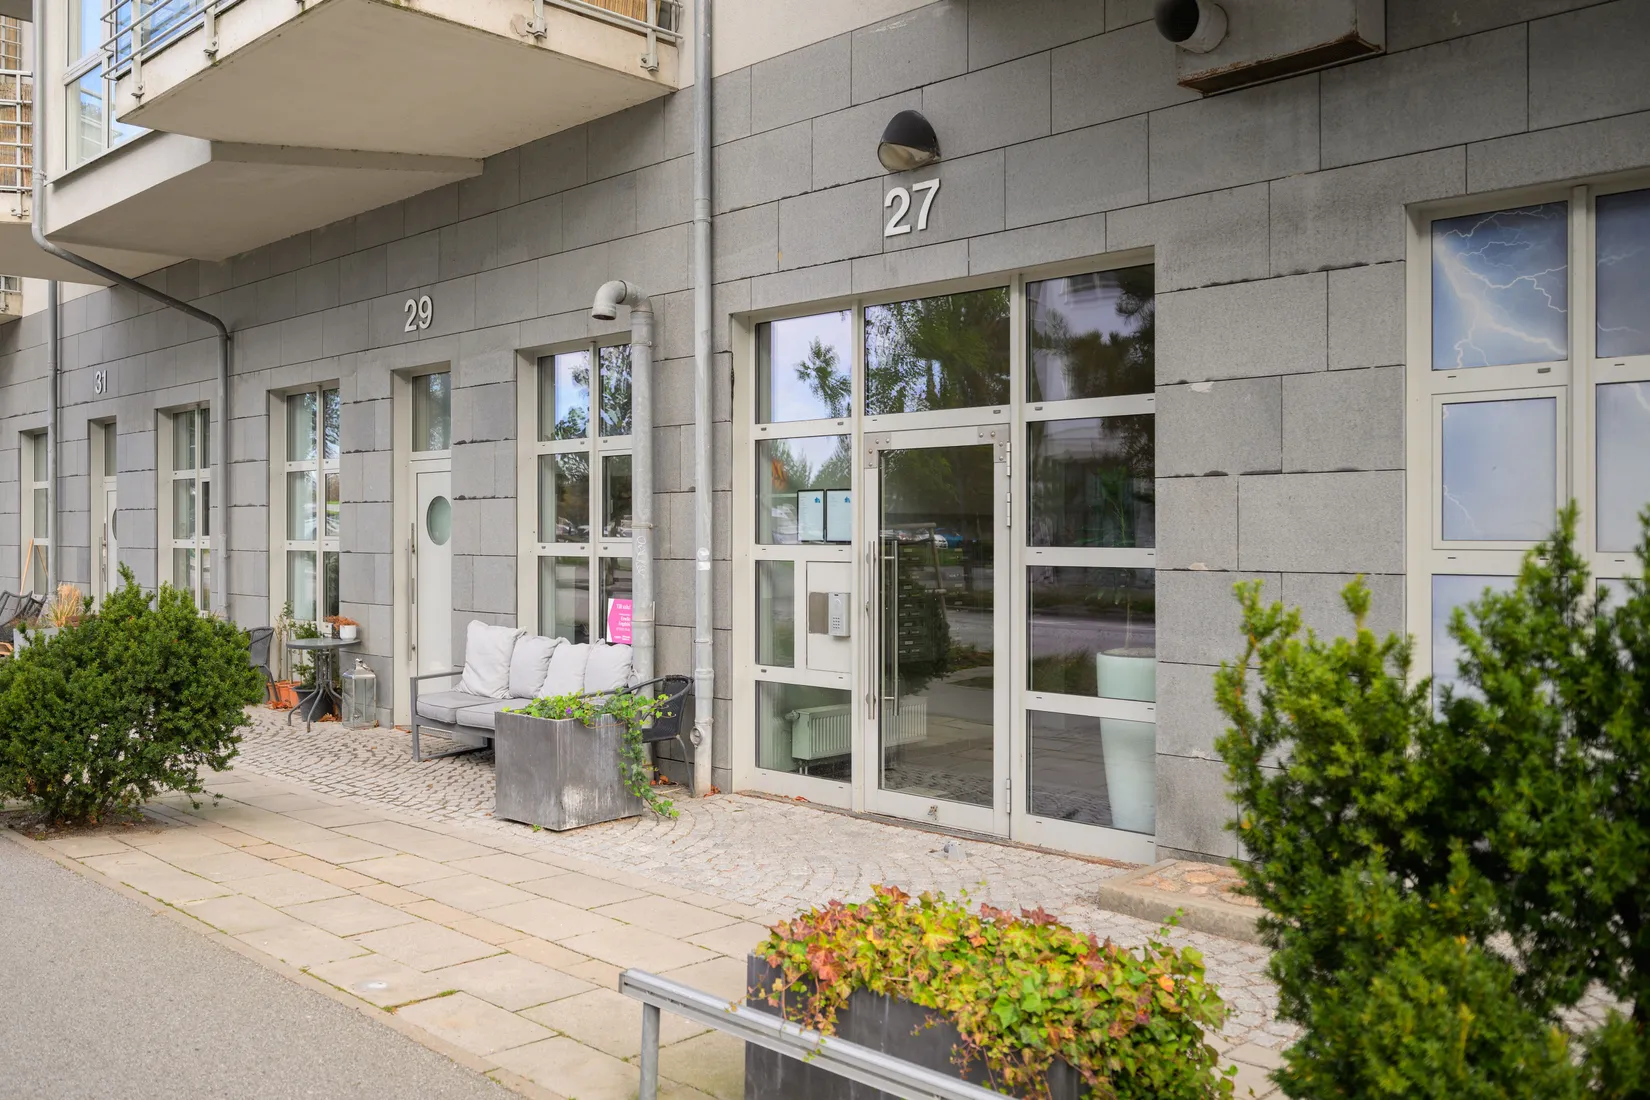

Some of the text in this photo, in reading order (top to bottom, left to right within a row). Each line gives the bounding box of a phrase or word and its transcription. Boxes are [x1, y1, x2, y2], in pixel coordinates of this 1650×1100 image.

[884, 178, 940, 237] 27
[404, 295, 434, 333] 29
[95, 369, 107, 394] 31
